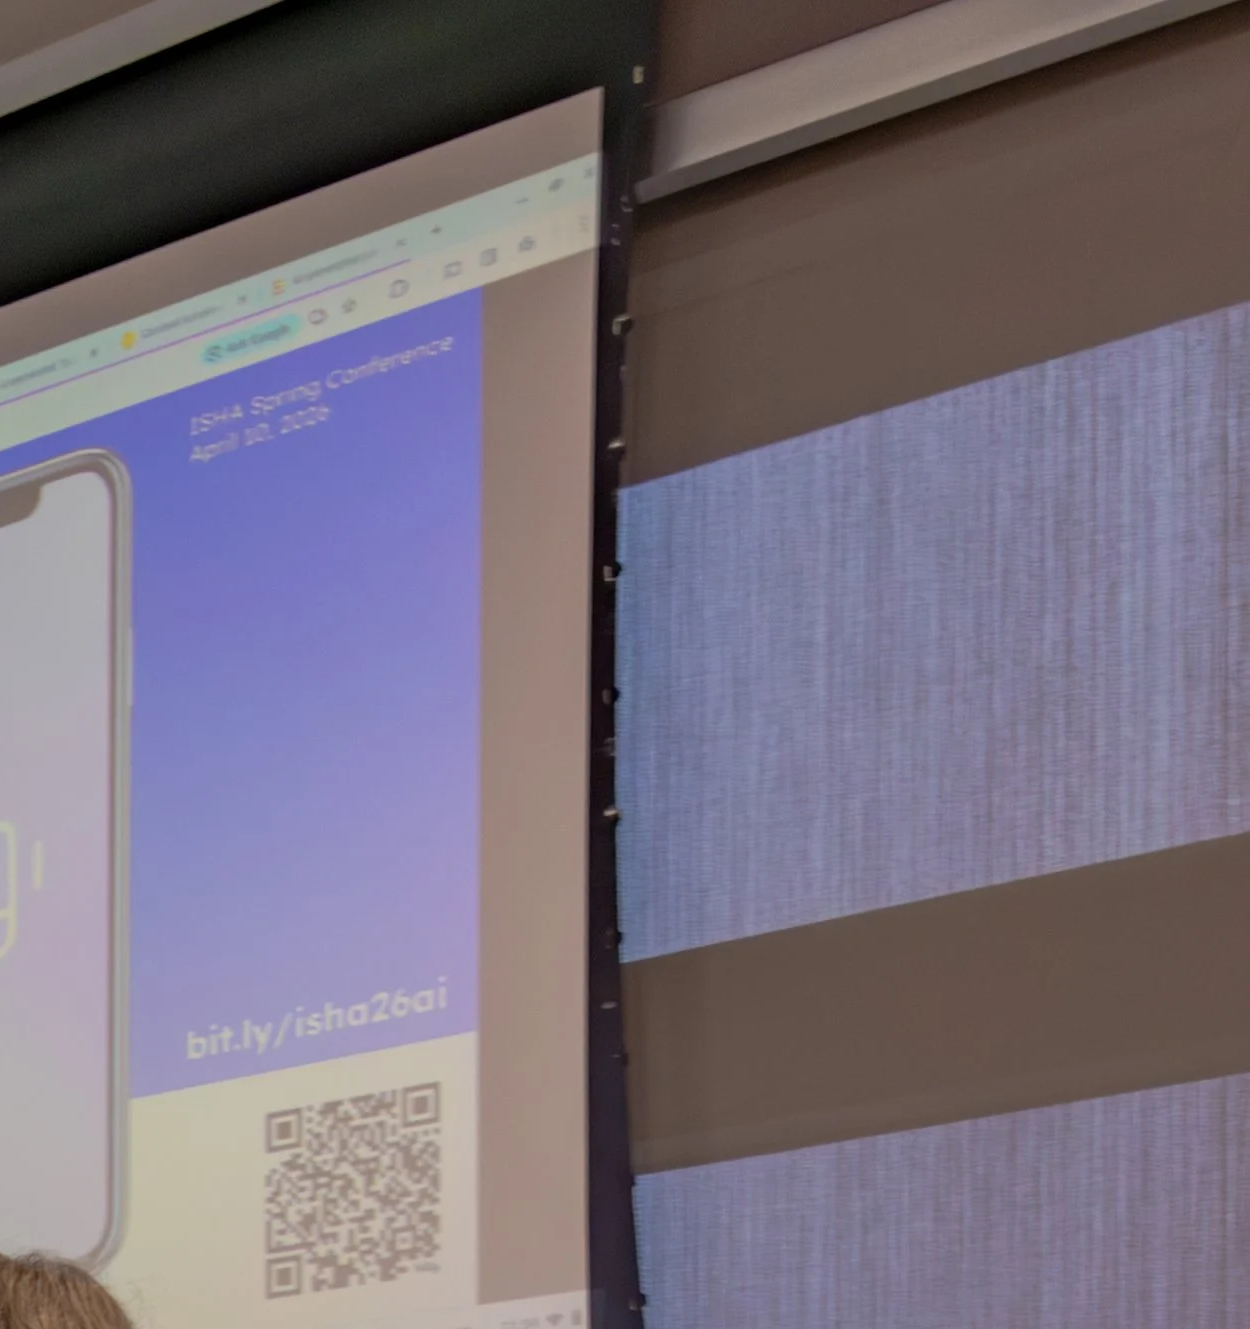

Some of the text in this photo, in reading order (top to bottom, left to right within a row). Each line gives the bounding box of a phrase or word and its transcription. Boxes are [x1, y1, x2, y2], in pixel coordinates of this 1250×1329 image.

[190, 336, 453, 435] ISHA Spring Conference
[190, 432, 240, 463] April
[186, 975, 447, 1060] bit.ly/isha26ai
